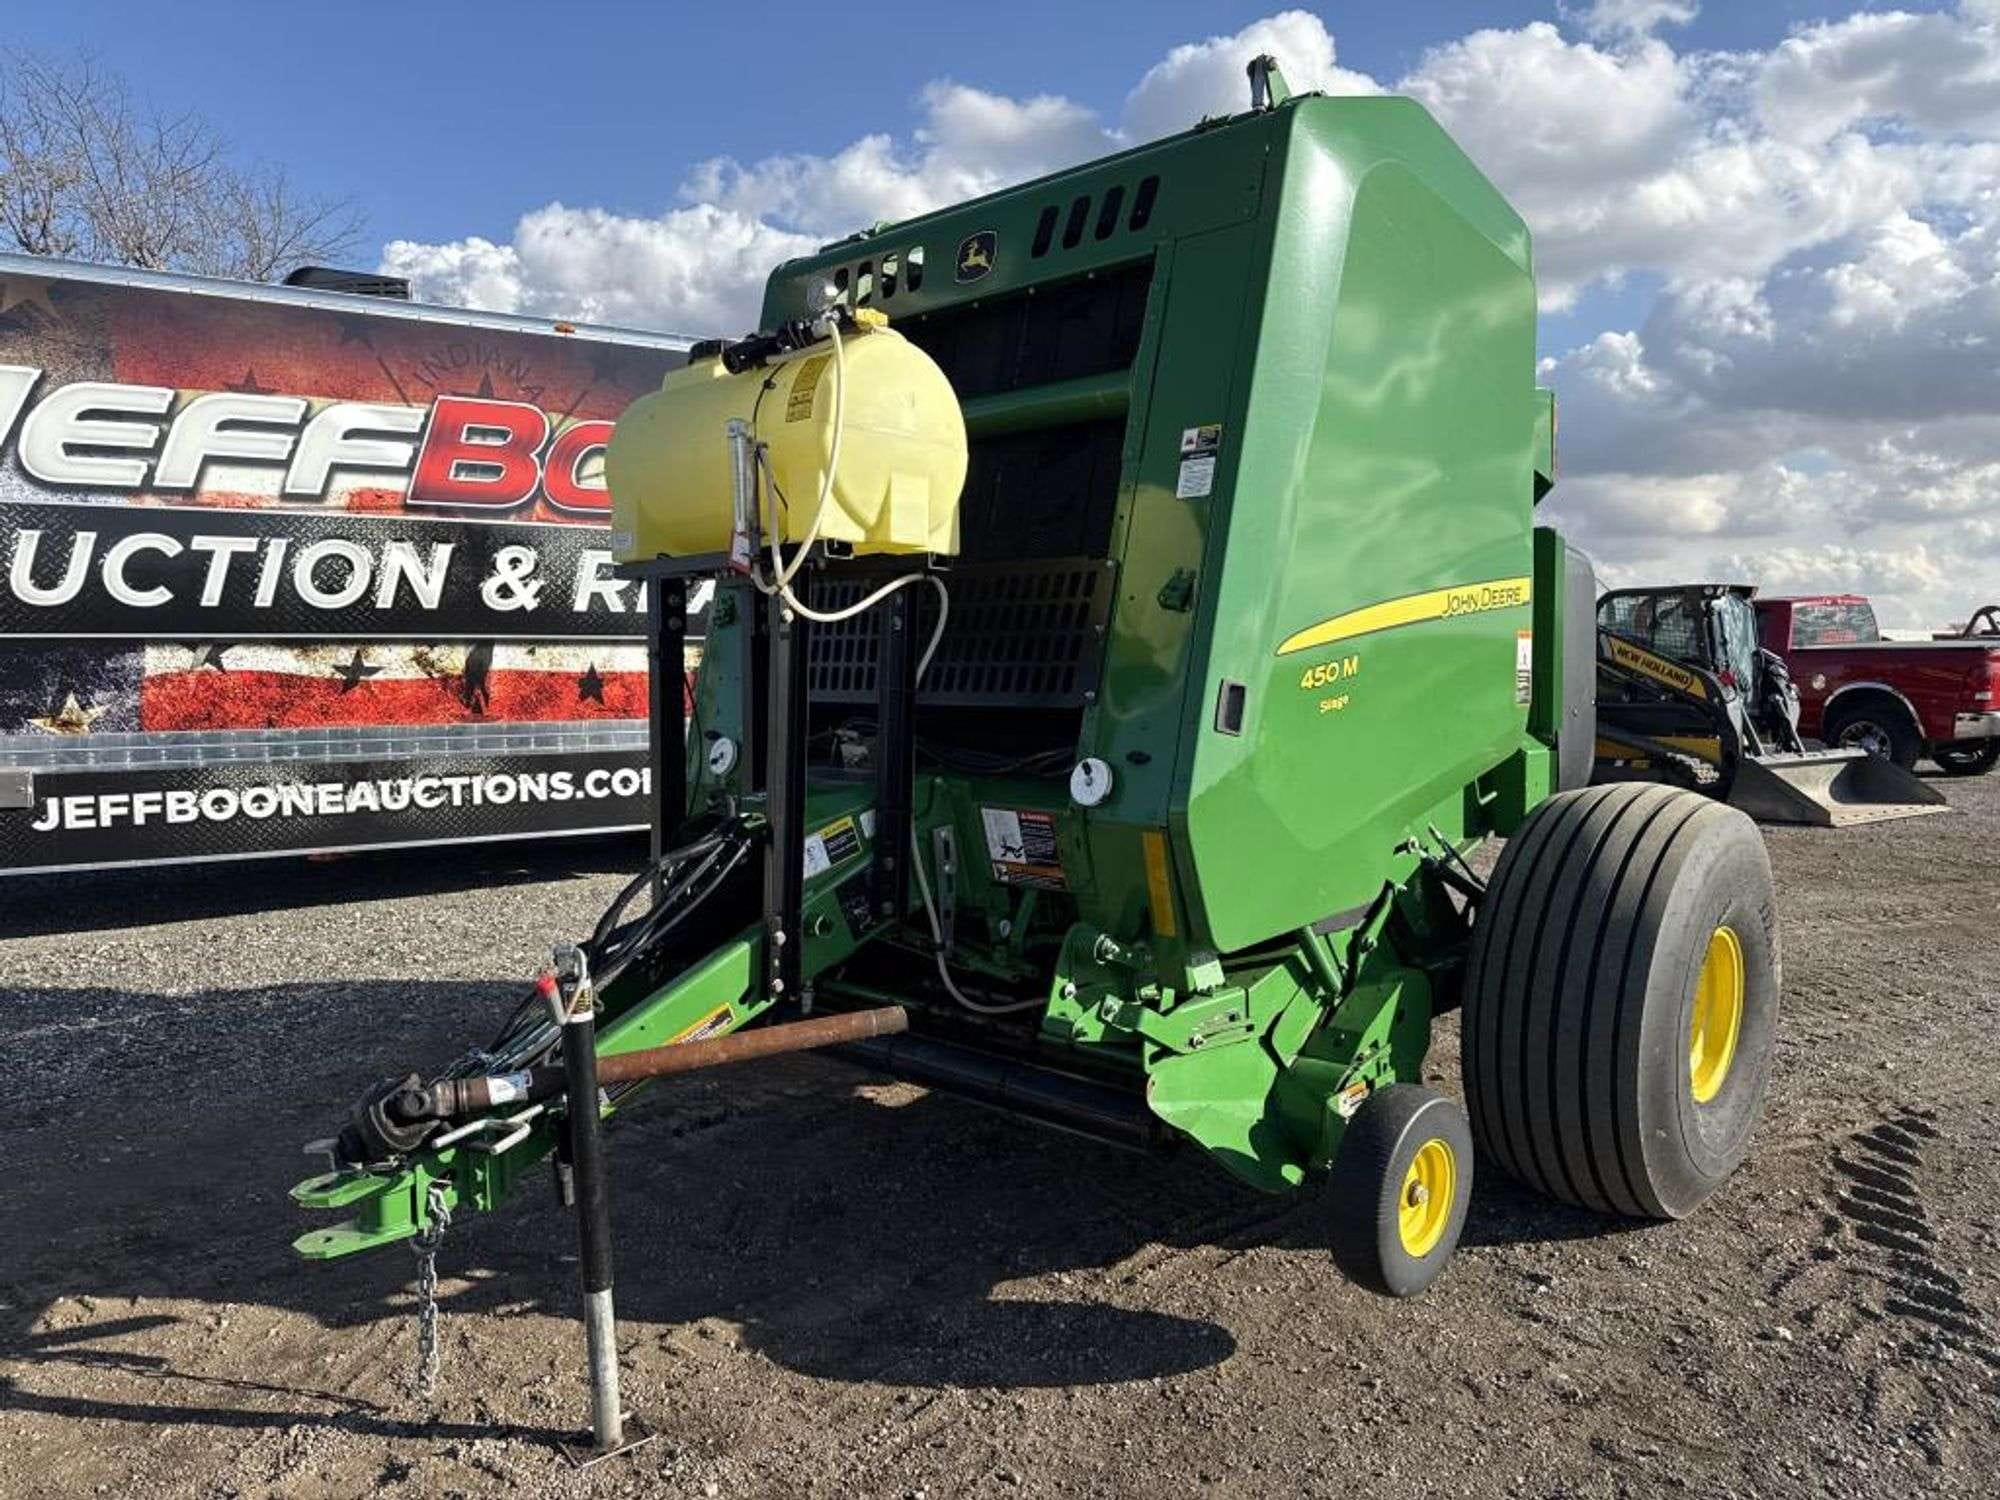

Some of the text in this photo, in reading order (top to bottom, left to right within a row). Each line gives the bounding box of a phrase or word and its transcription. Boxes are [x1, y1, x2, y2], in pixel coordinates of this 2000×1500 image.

[10, 529, 455, 609] UCTION
[480, 545, 544, 612] &
[1441, 586, 1522, 614] JOHN DEERE
[1301, 655, 1359, 689] 450 M
[32, 767, 651, 831] JEFFBOONEAUCTIONS.CO
